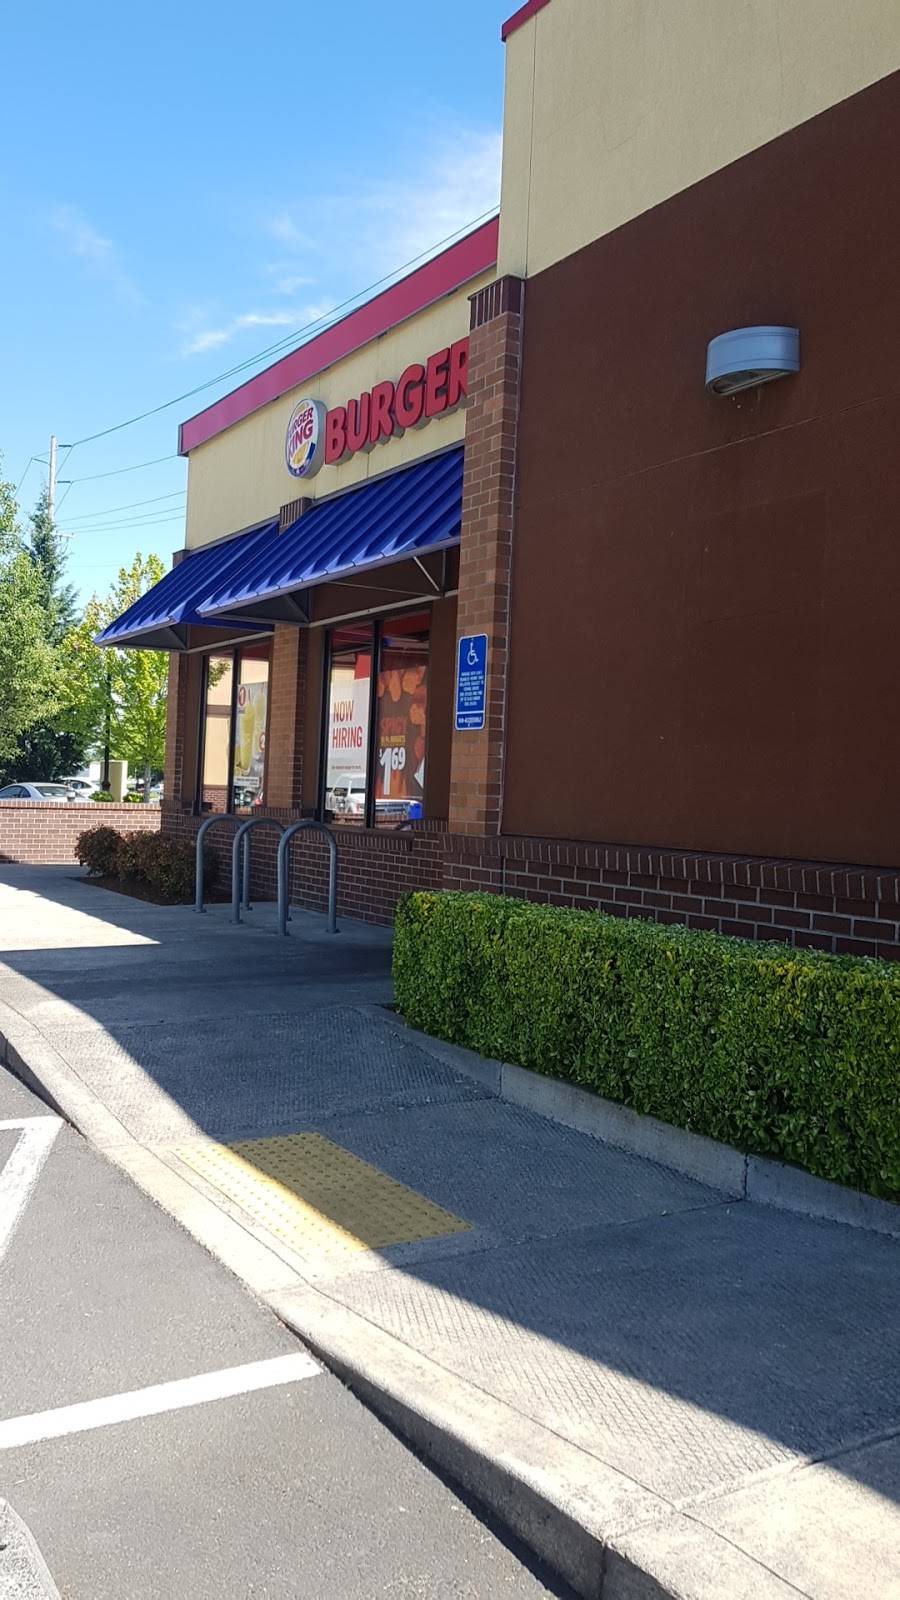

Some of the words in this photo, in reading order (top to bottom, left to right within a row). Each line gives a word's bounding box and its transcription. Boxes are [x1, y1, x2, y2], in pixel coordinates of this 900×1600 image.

[325, 336, 470, 465] BURGER
[333, 700, 354, 723] NOW
[332, 726, 363, 749] HIRING
